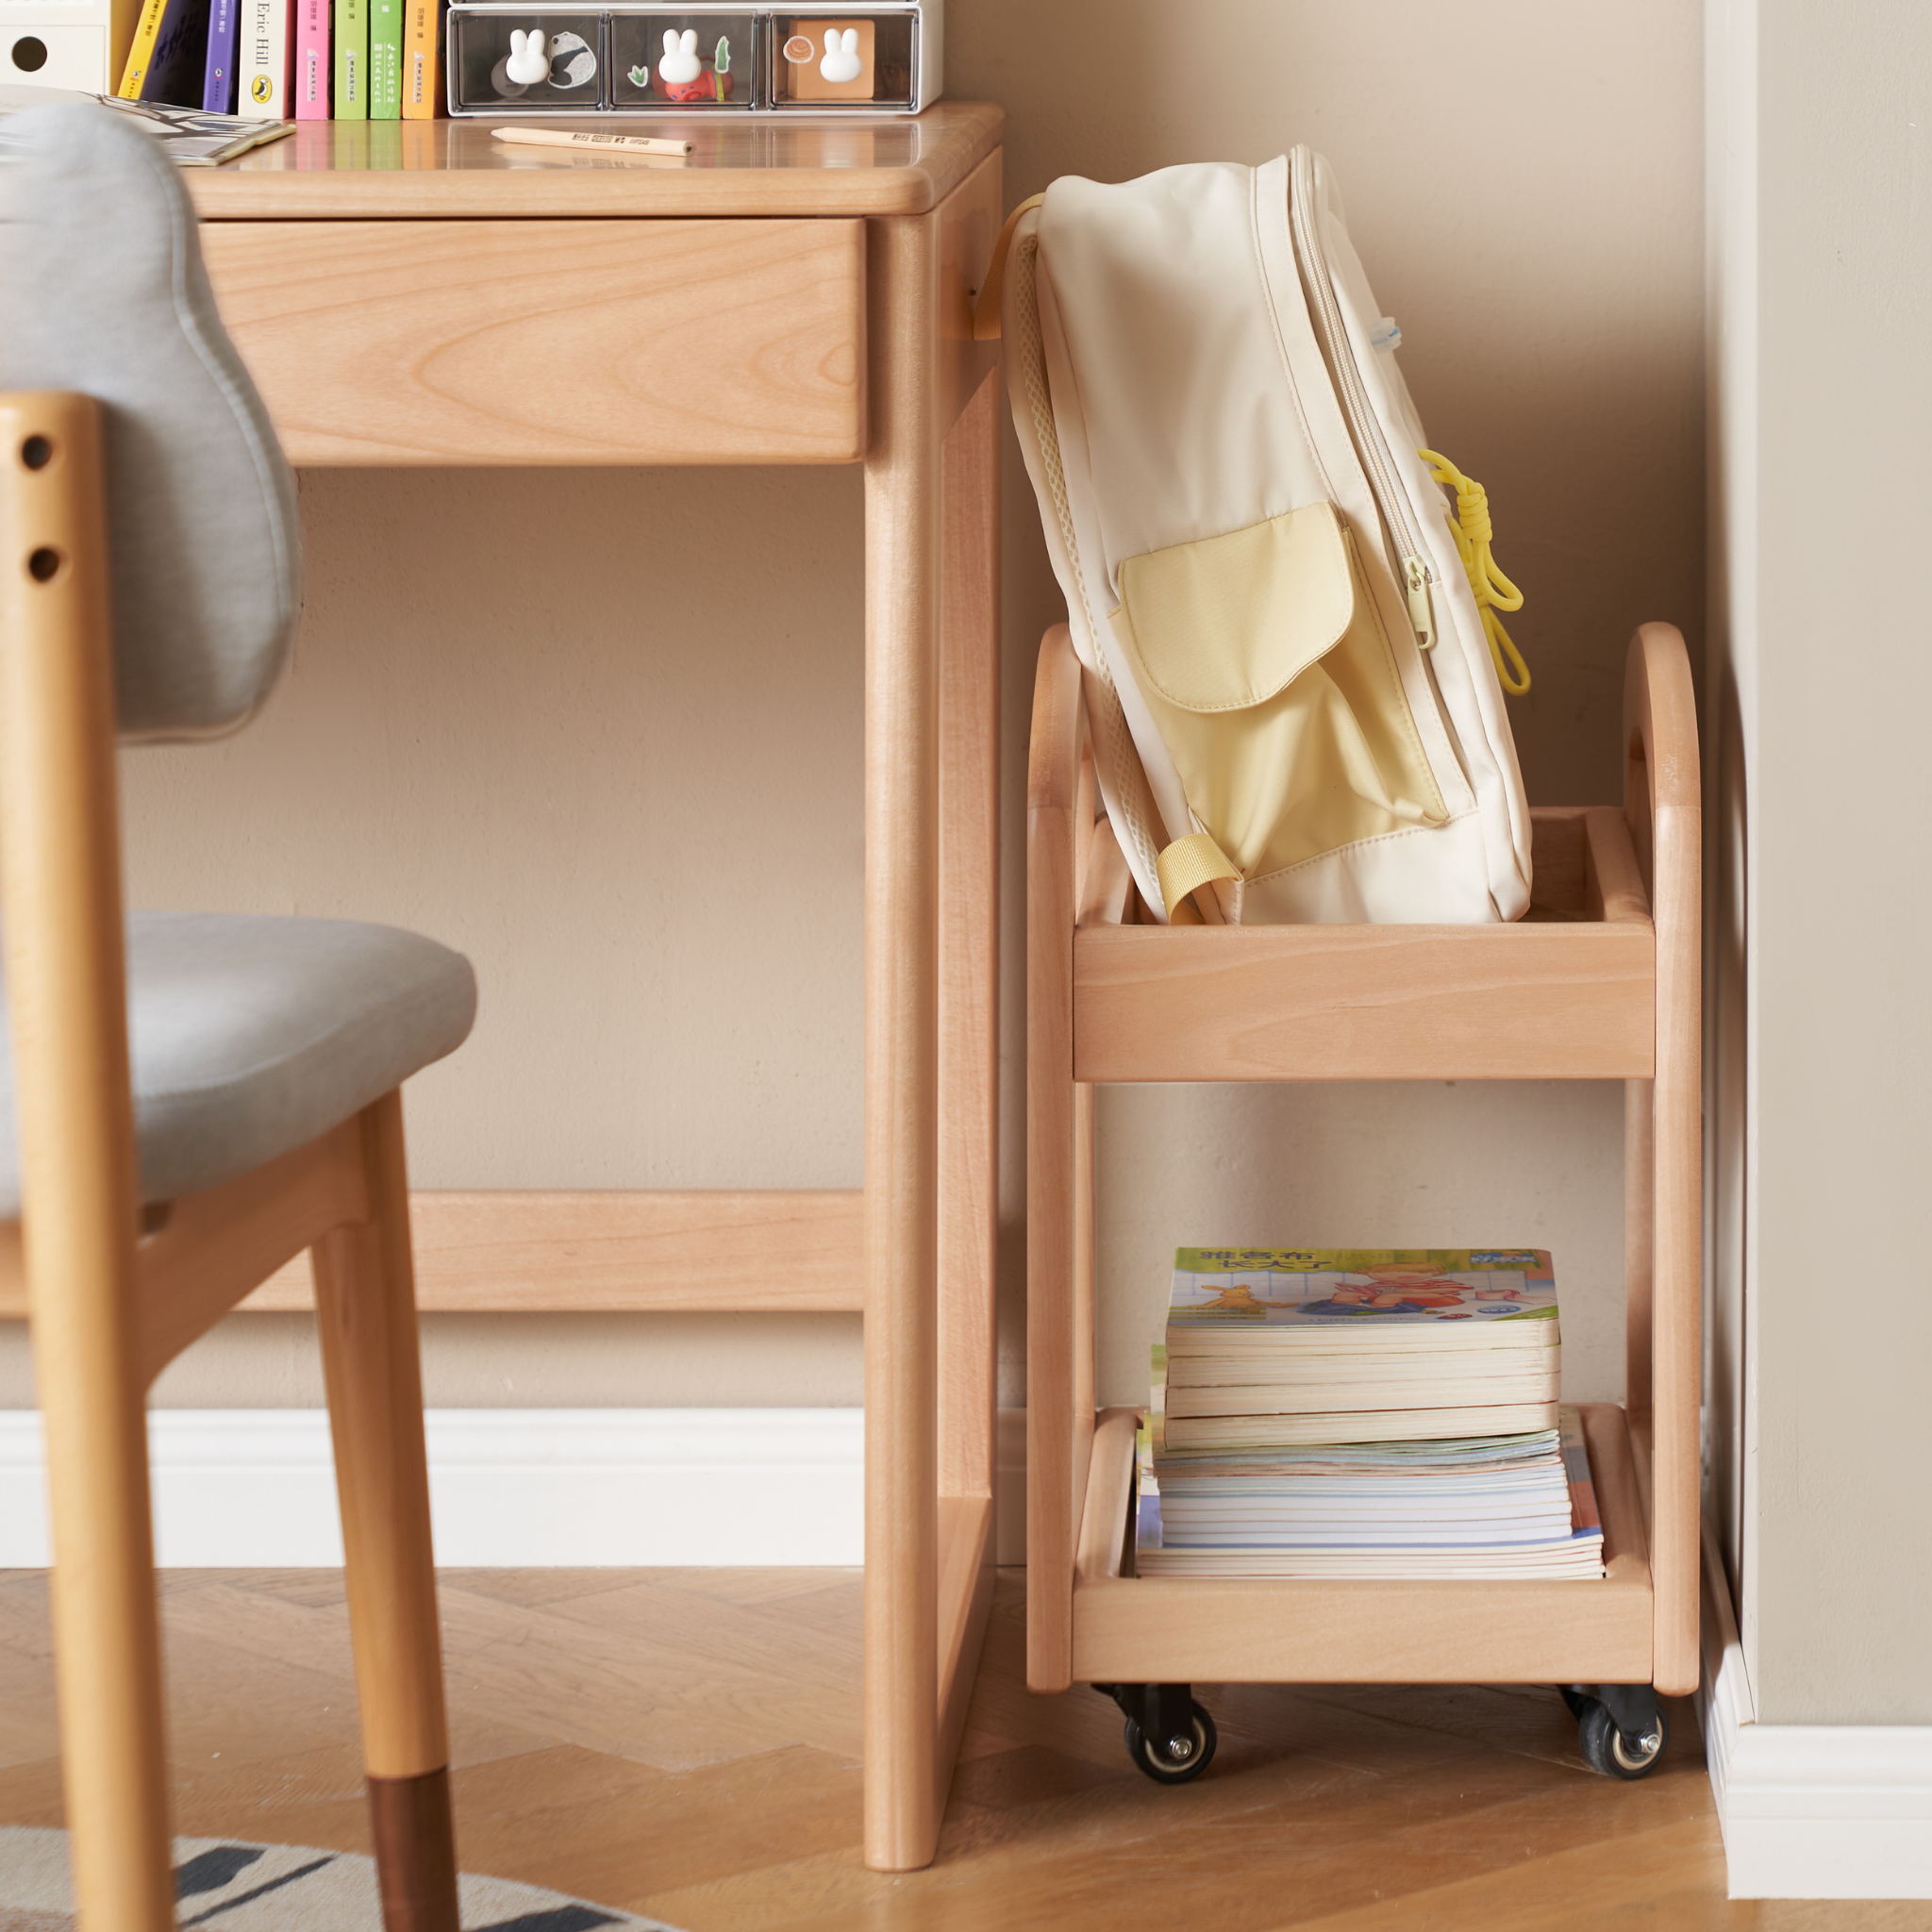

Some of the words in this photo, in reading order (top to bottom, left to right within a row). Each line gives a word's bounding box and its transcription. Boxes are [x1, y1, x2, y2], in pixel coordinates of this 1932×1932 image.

[257, 3, 270, 33] Eric
[256, 38, 269, 65] Hill
[1199, 1251, 1315, 1260] 雅各布
[1218, 1259, 1332, 1270] 长大了
